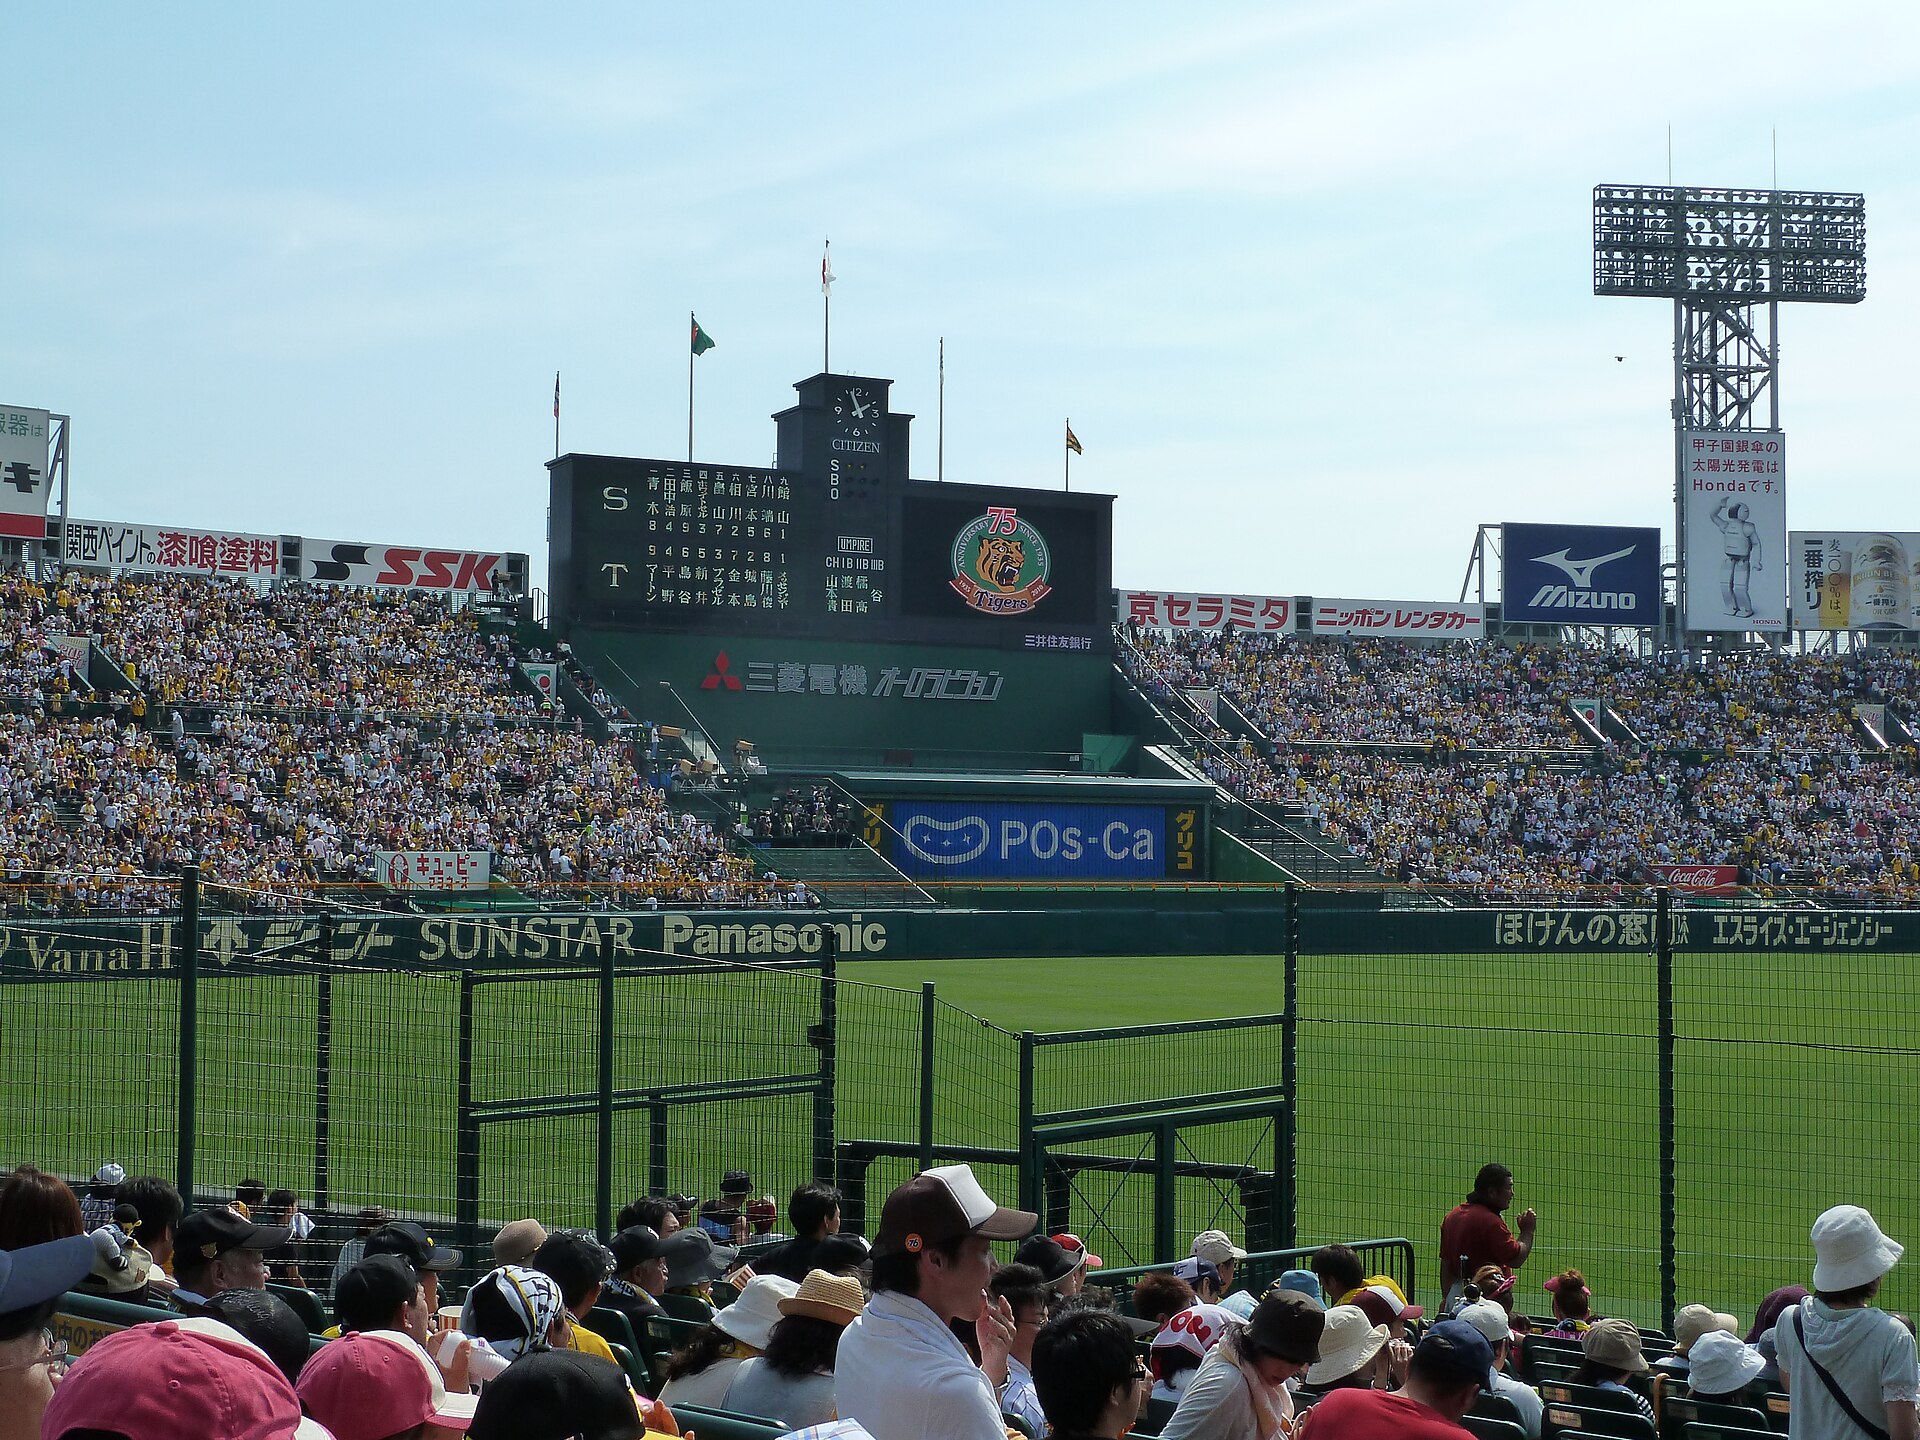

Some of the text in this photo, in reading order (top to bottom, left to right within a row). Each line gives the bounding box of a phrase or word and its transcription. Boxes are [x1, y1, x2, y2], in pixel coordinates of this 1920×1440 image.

[834, 406, 842, 415] 9
[871, 409, 880, 418] 3
[832, 439, 880, 453] CITIZEN
[852, 428, 861, 437] 6
[1693, 438, 1779, 453] 甲子園銀傘の
[830, 459, 840, 471] S
[830, 473, 840, 486] B
[1693, 459, 1779, 474] 太陽光発電は
[602, 486, 629, 511] S
[646, 476, 660, 516] 青木
[663, 478, 676, 517] 田中浩
[679, 479, 693, 517] 飯原
[728, 482, 742, 522] 相川
[744, 483, 758, 522] 宮本
[1693, 480, 1779, 494] Hondaです。
[777, 485, 791, 525] 館山
[987, 507, 1018, 535] 75
[649, 520, 657, 531] 8
[665, 521, 673, 532] 4
[682, 522, 690, 533] 9
[698, 523, 706, 534] 3
[715, 524, 723, 535] 7
[731, 525, 739, 536] 2
[747, 526, 755, 537] 5
[763, 527, 771, 538] 6
[840, 538, 870, 551] UMPIRE
[957, 519, 990, 568] ANNIVERSARY
[1018, 524, 1045, 567] SINCE 1935
[66, 523, 280, 575] 関西ペイントの漆喰塗料
[648, 544, 656, 556] 9
[665, 546, 673, 557] 4
[682, 547, 690, 558] 6
[698, 548, 706, 559] 5
[714, 549, 722, 560] 3
[731, 550, 738, 561] 7
[747, 551, 755, 562] 2
[763, 552, 771, 563] 8
[825, 556, 839, 568] CH
[375, 548, 501, 591] SSK
[600, 563, 629, 587] T
[646, 564, 658, 602] マートン
[661, 564, 675, 603] 平野
[678, 565, 692, 605] 鳥谷
[694, 566, 708, 605] 新井
[1804, 540, 1824, 610] 一番搾り
[727, 568, 741, 607] 金本
[870, 588, 883, 603] 谷
[974, 591, 1029, 612] Tigers
[1127, 593, 1289, 630] 京セラミタ
[1025, 634, 1092, 650] 三井住友銀行
[745, 662, 869, 695] 三菱電機
[863, 803, 884, 854] グリ
[1001, 819, 1155, 862] POs-Ca
[1176, 809, 1196, 871] グリコ
[417, 853, 477, 876] キューピー
[1668, 868, 1718, 887] Coca-Cola
[419, 917, 635, 961] SUNSTAR
[663, 914, 887, 955] Panasonic
